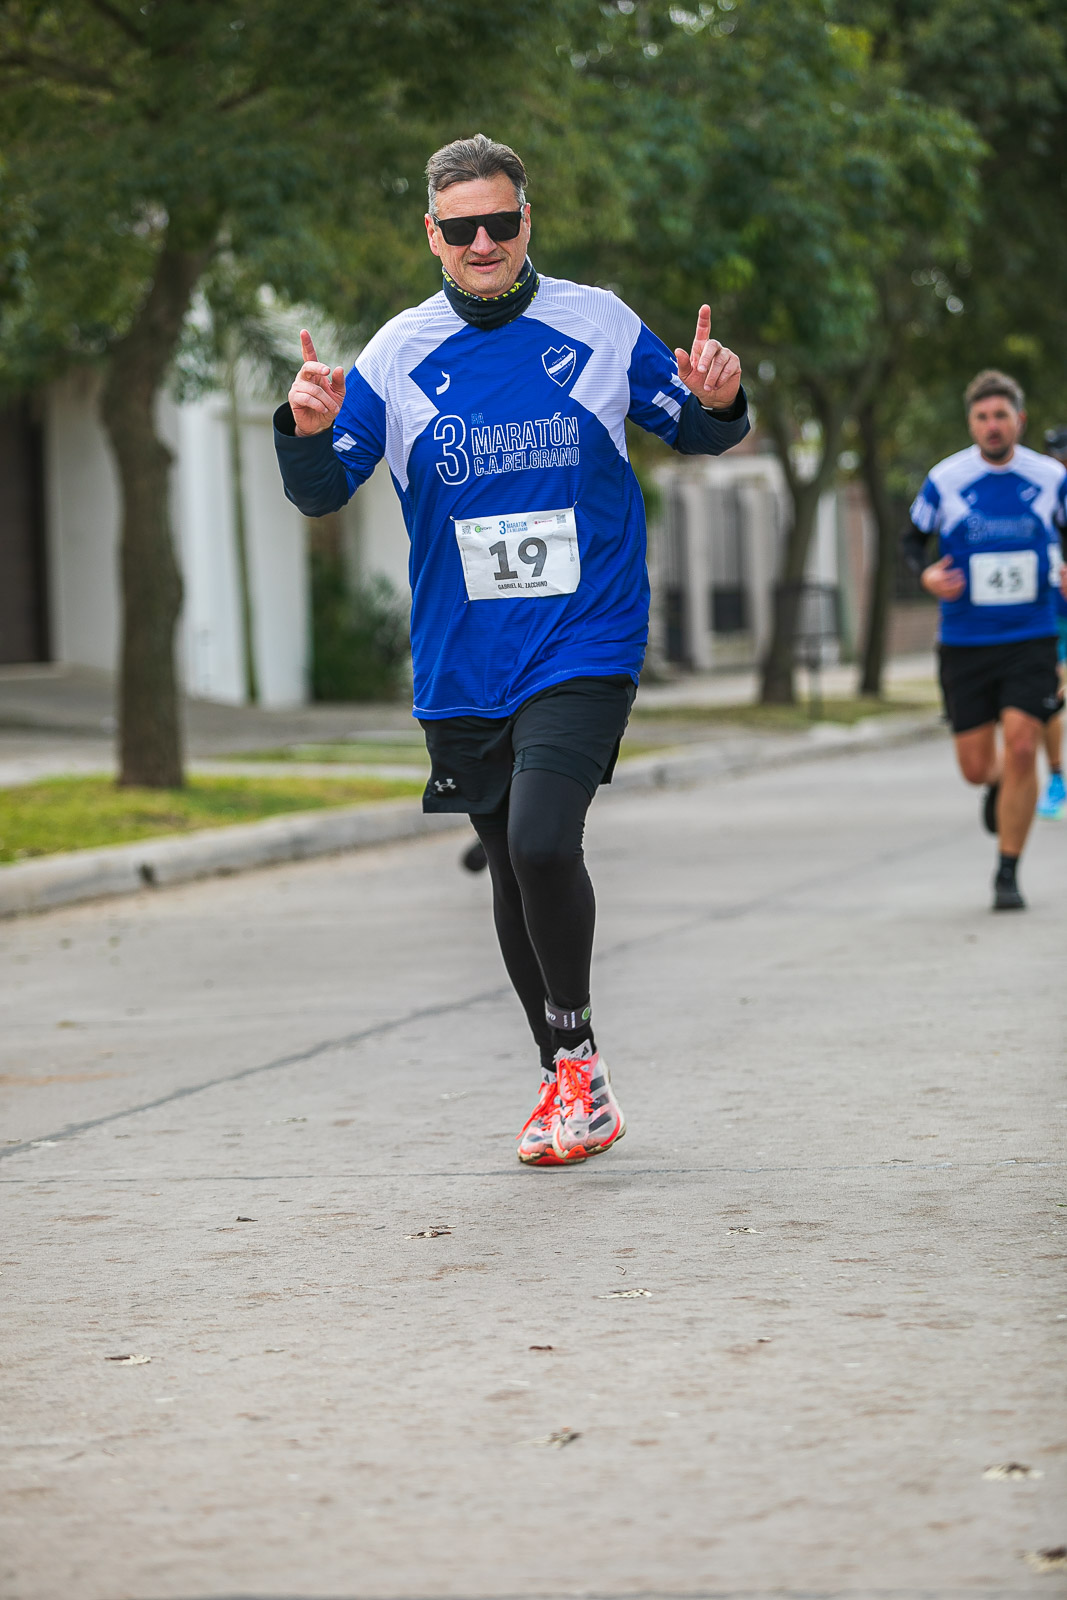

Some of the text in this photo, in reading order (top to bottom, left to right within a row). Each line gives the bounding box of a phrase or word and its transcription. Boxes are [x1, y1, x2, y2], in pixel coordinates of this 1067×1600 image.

[433, 411, 580, 486] 3 MARATÓN
[473, 446, 580, 477] C.A.BELGRANO
[498, 520, 506, 535] 3
[488, 536, 548, 581] 19
[497, 582, 517, 590] GABRIEL
[525, 580, 548, 589] ZACCHINO
